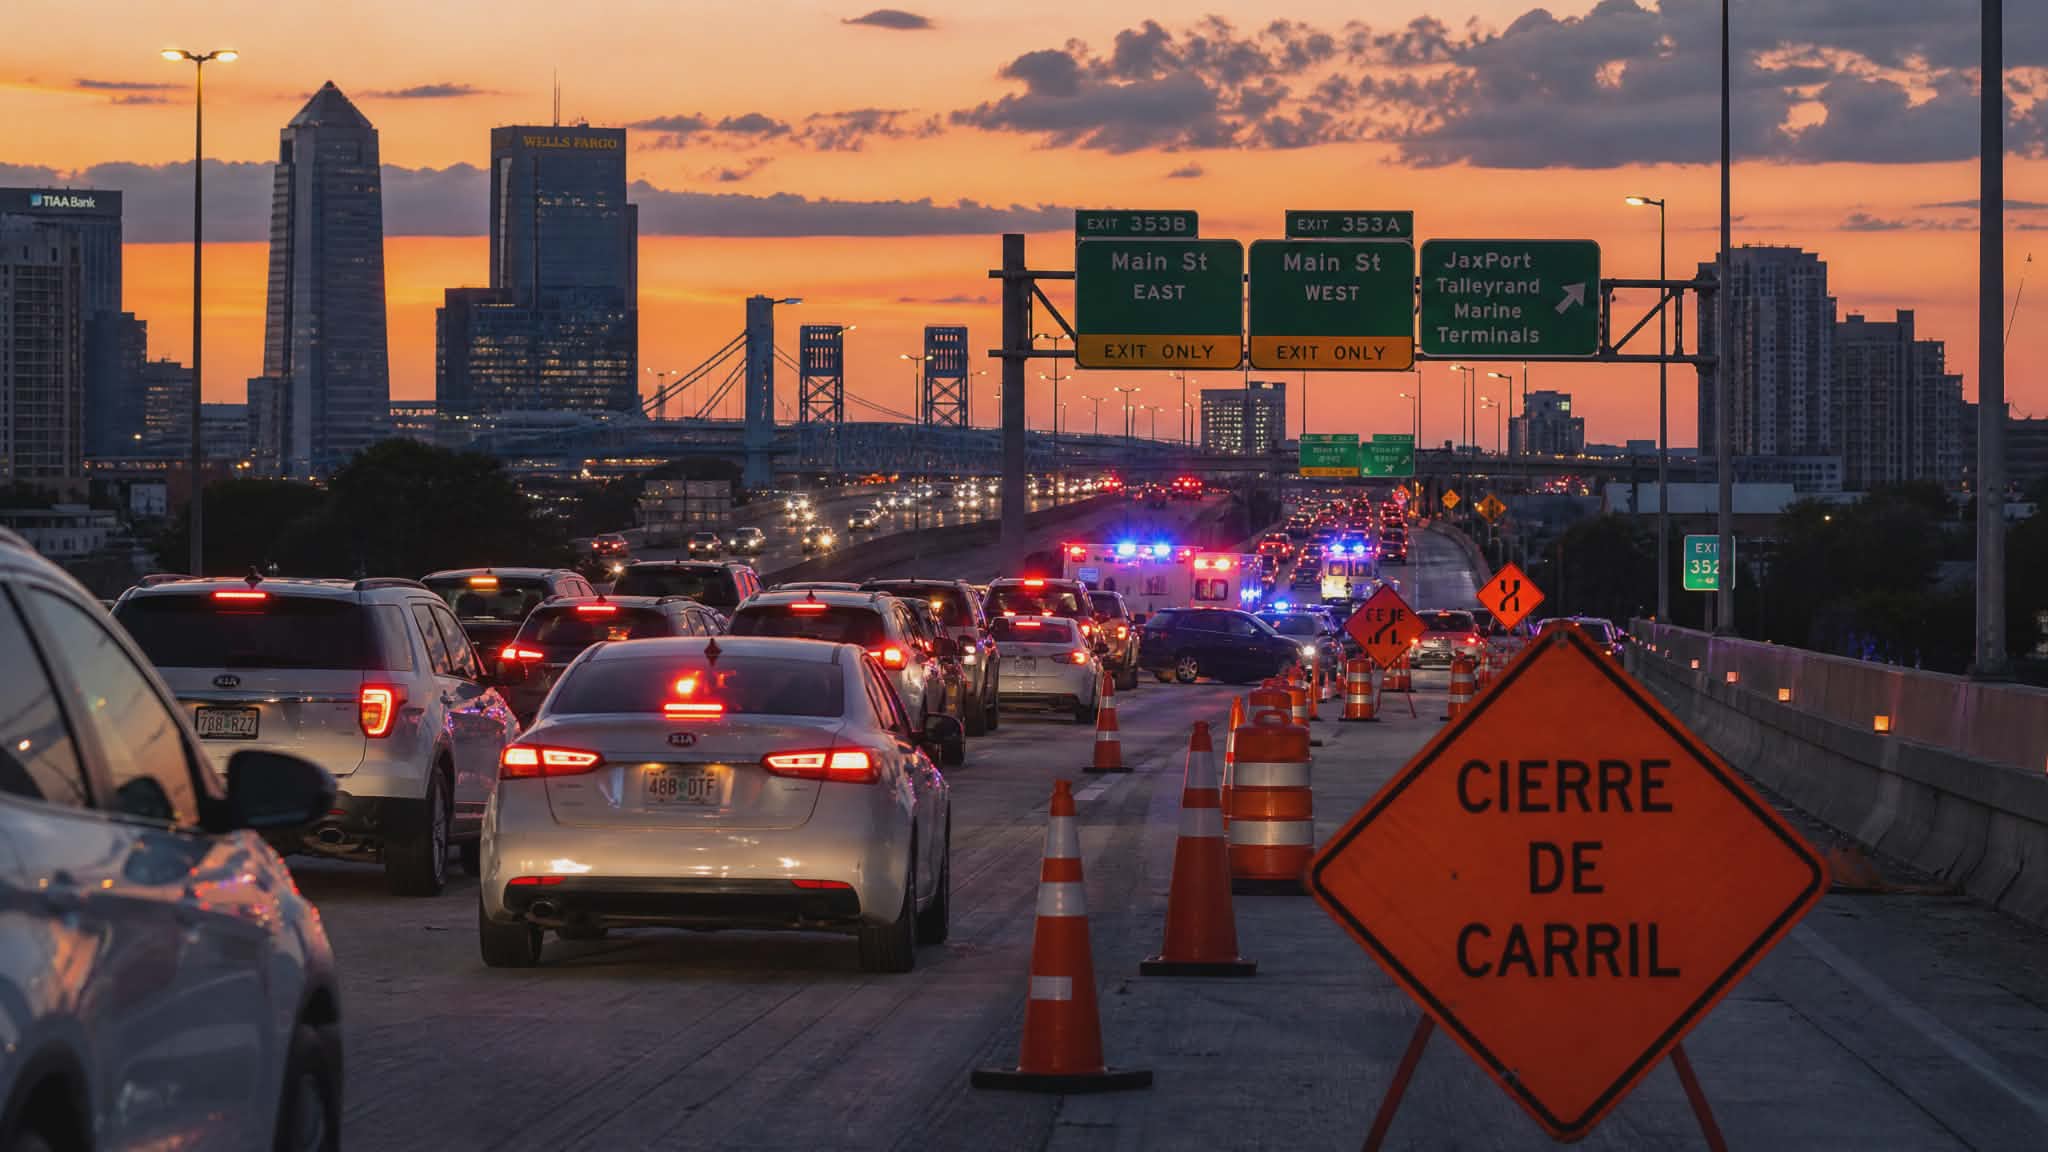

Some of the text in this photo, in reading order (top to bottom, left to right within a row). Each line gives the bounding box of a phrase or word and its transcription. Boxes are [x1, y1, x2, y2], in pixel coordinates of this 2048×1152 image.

[523, 135, 617, 150] WELLS FARGO
[43, 195, 96, 208] TIAA Bank
[1087, 216, 1187, 232] EXIT 353B
[1297, 216, 1400, 232] EXIT 353A
[1111, 252, 1208, 271] Main St
[1283, 252, 1382, 272] Main St
[1444, 251, 1532, 269] JaxPort
[1133, 284, 1186, 300] EAST
[1304, 284, 1360, 301] WEST
[1436, 277, 1541, 298] Talleyrand
[1454, 302, 1522, 319] Marine
[1436, 326, 1540, 344] Terminals
[1104, 343, 1214, 359] EXIT ONLY
[1277, 345, 1386, 361] EXIT ONLY
[1695, 543, 1719, 553] EXI
[1456, 759, 1673, 813] CIERRE
[1528, 841, 1604, 894] DE
[1455, 923, 1681, 978] CARRIL
